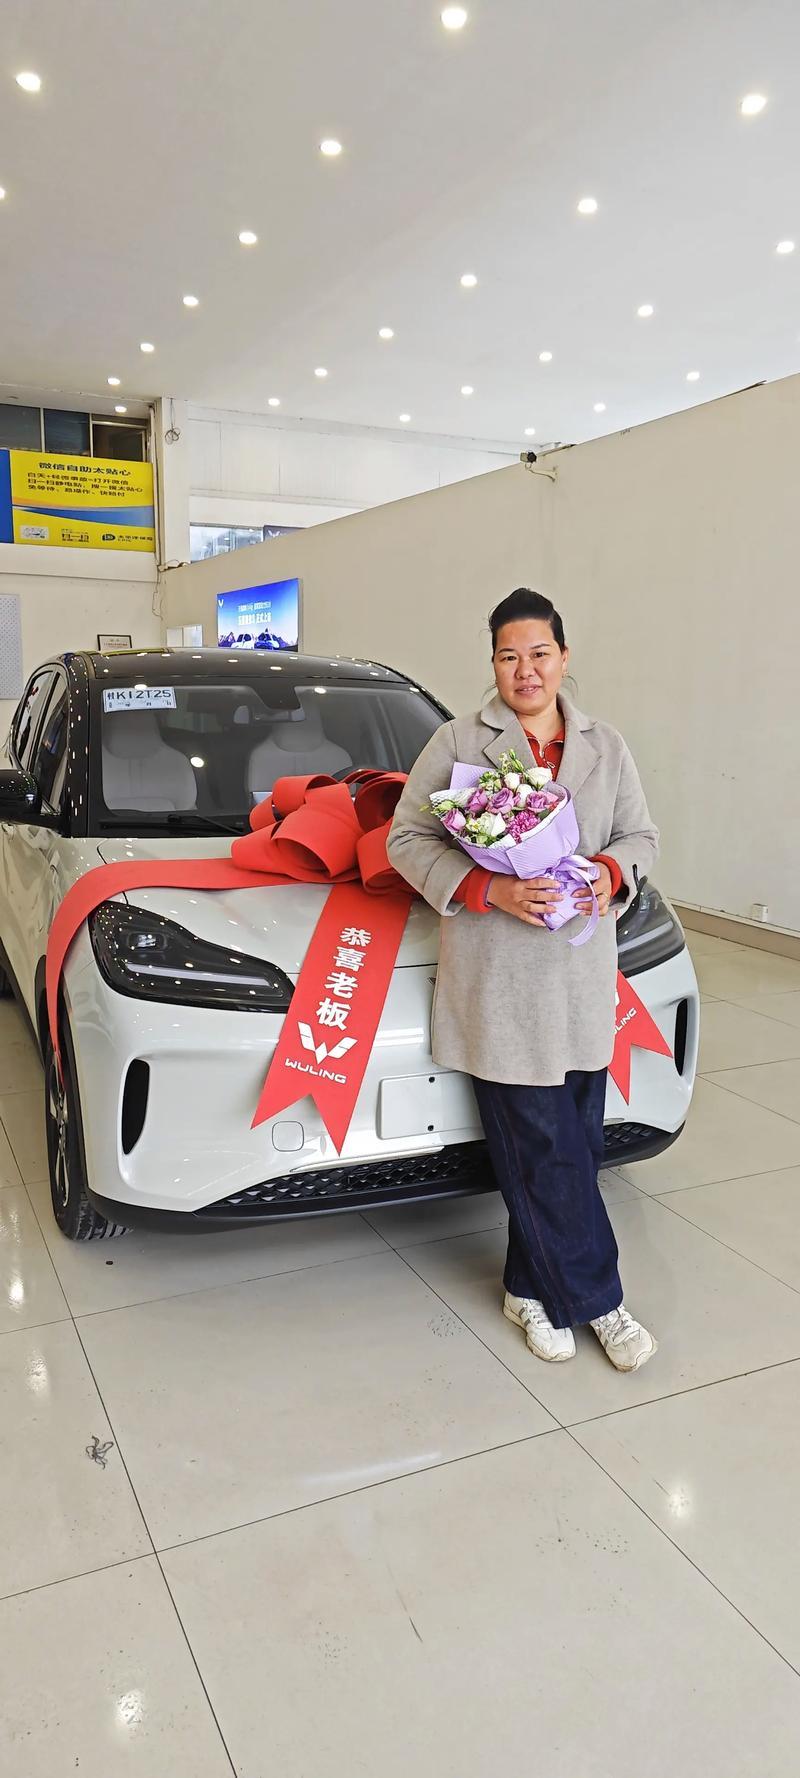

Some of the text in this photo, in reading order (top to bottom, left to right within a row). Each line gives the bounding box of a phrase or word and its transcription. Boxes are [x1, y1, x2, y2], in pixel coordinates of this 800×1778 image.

[39, 462, 131, 476] 微信自助太贴心
[315, 926, 372, 1031] 恭喜老板
[284, 1058, 347, 1084] WULING
